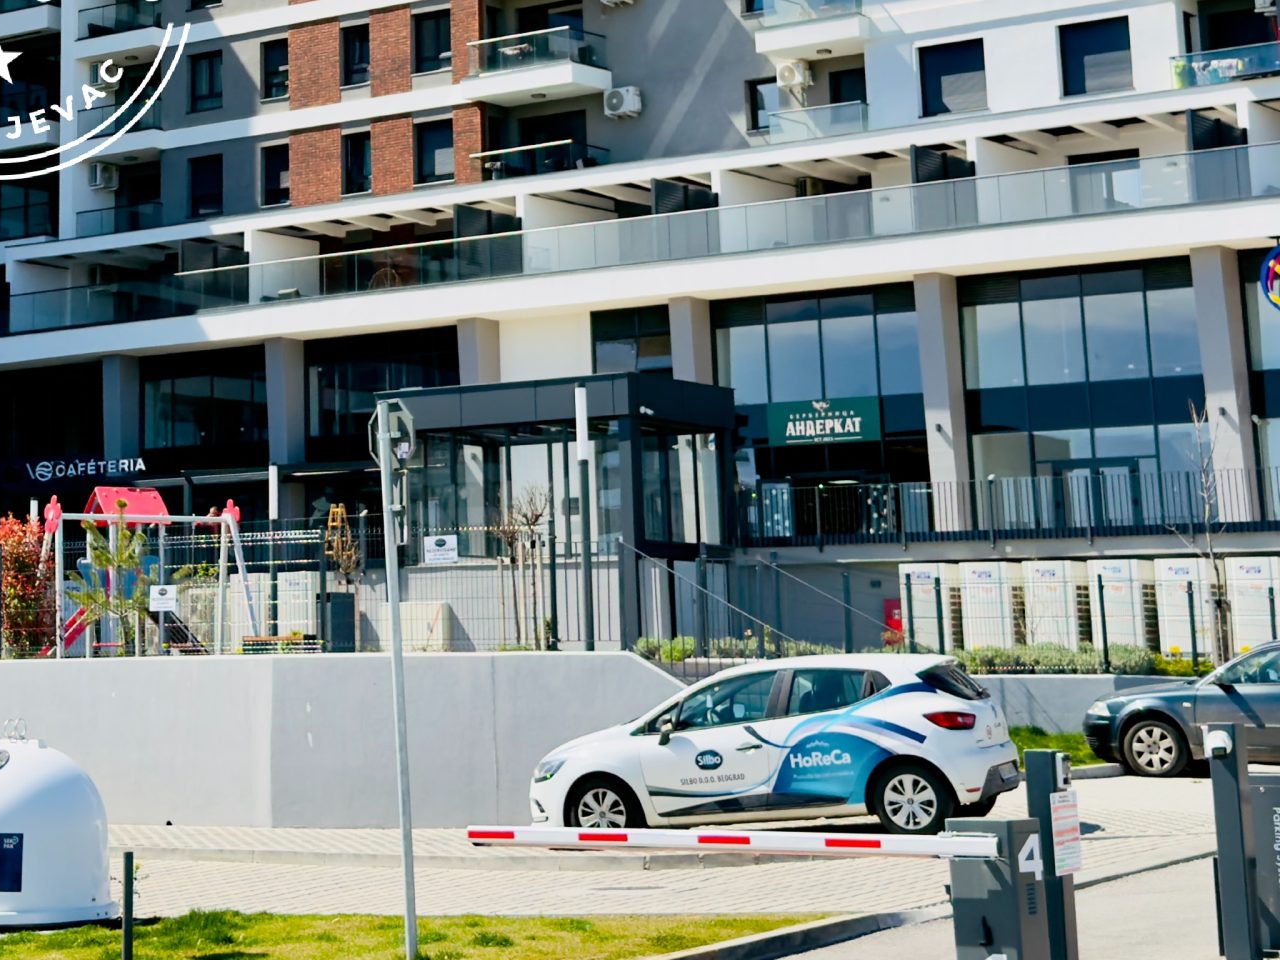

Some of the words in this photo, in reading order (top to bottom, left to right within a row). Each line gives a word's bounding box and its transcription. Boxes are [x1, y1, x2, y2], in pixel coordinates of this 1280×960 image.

[786, 417, 862, 436] АНДЕРКАТ
[697, 754, 721, 766] Silbo
[790, 749, 851, 768] HoReCa
[1018, 833, 1043, 881] 4
